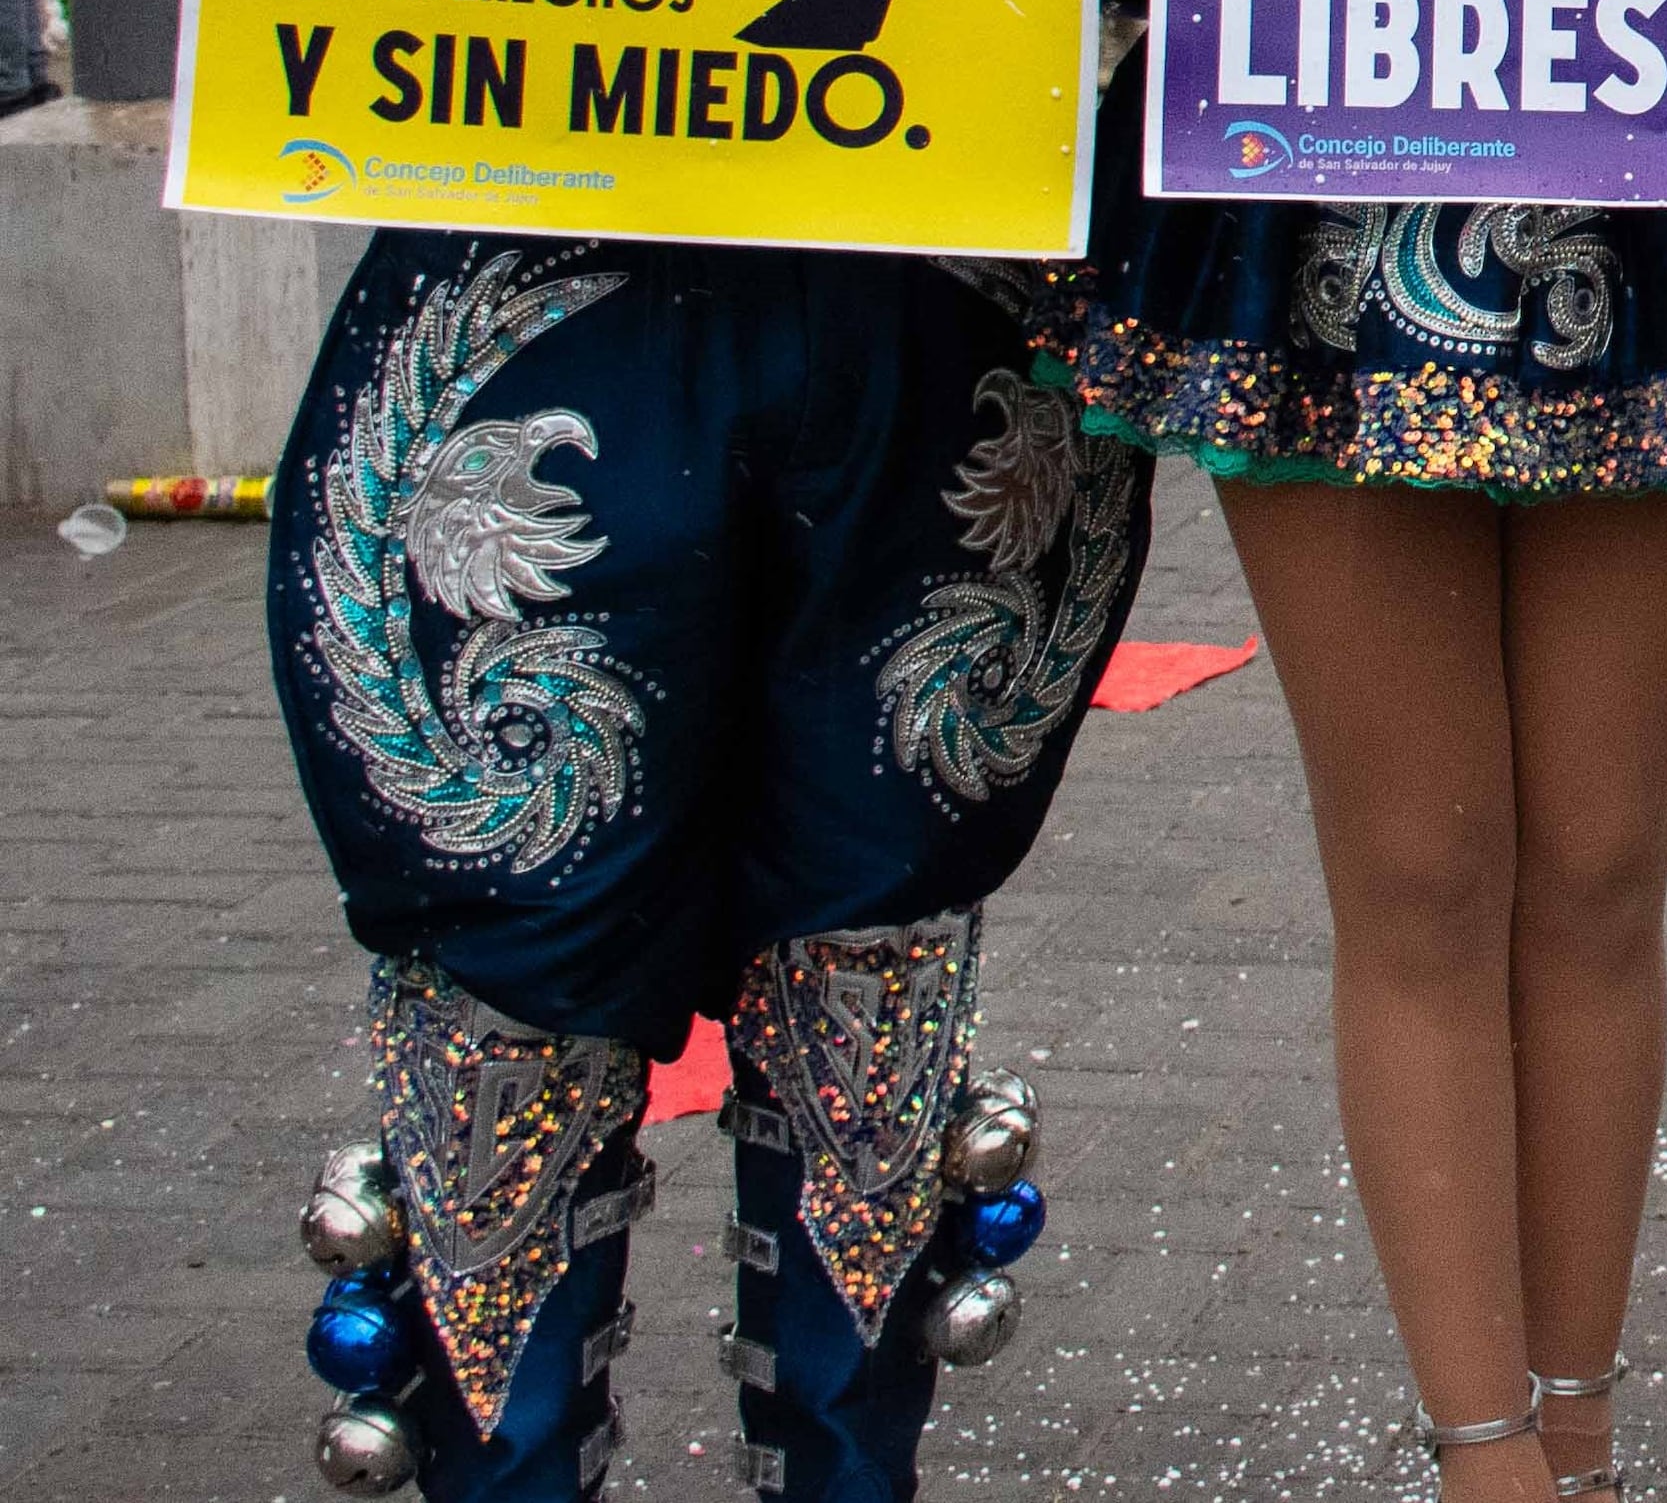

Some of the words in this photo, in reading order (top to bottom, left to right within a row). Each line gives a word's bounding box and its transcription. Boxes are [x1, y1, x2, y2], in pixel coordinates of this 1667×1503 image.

[276, 24, 333, 116] Y
[370, 31, 525, 128] SIN
[570, 44, 929, 149] MIEDO.
[1299, 134, 1386, 159] Concejo
[1393, 136, 1516, 157] Deliberante
[364, 156, 465, 186] Concejo
[474, 162, 615, 190] Deliberante
[1298, 158, 1314, 169] de
[1318, 158, 1340, 170] San
[1345, 159, 1399, 171] Salvador
[1402, 160, 1417, 171] de
[1420, 160, 1452, 174] Jujuy
[386, 186, 412, 198] San
